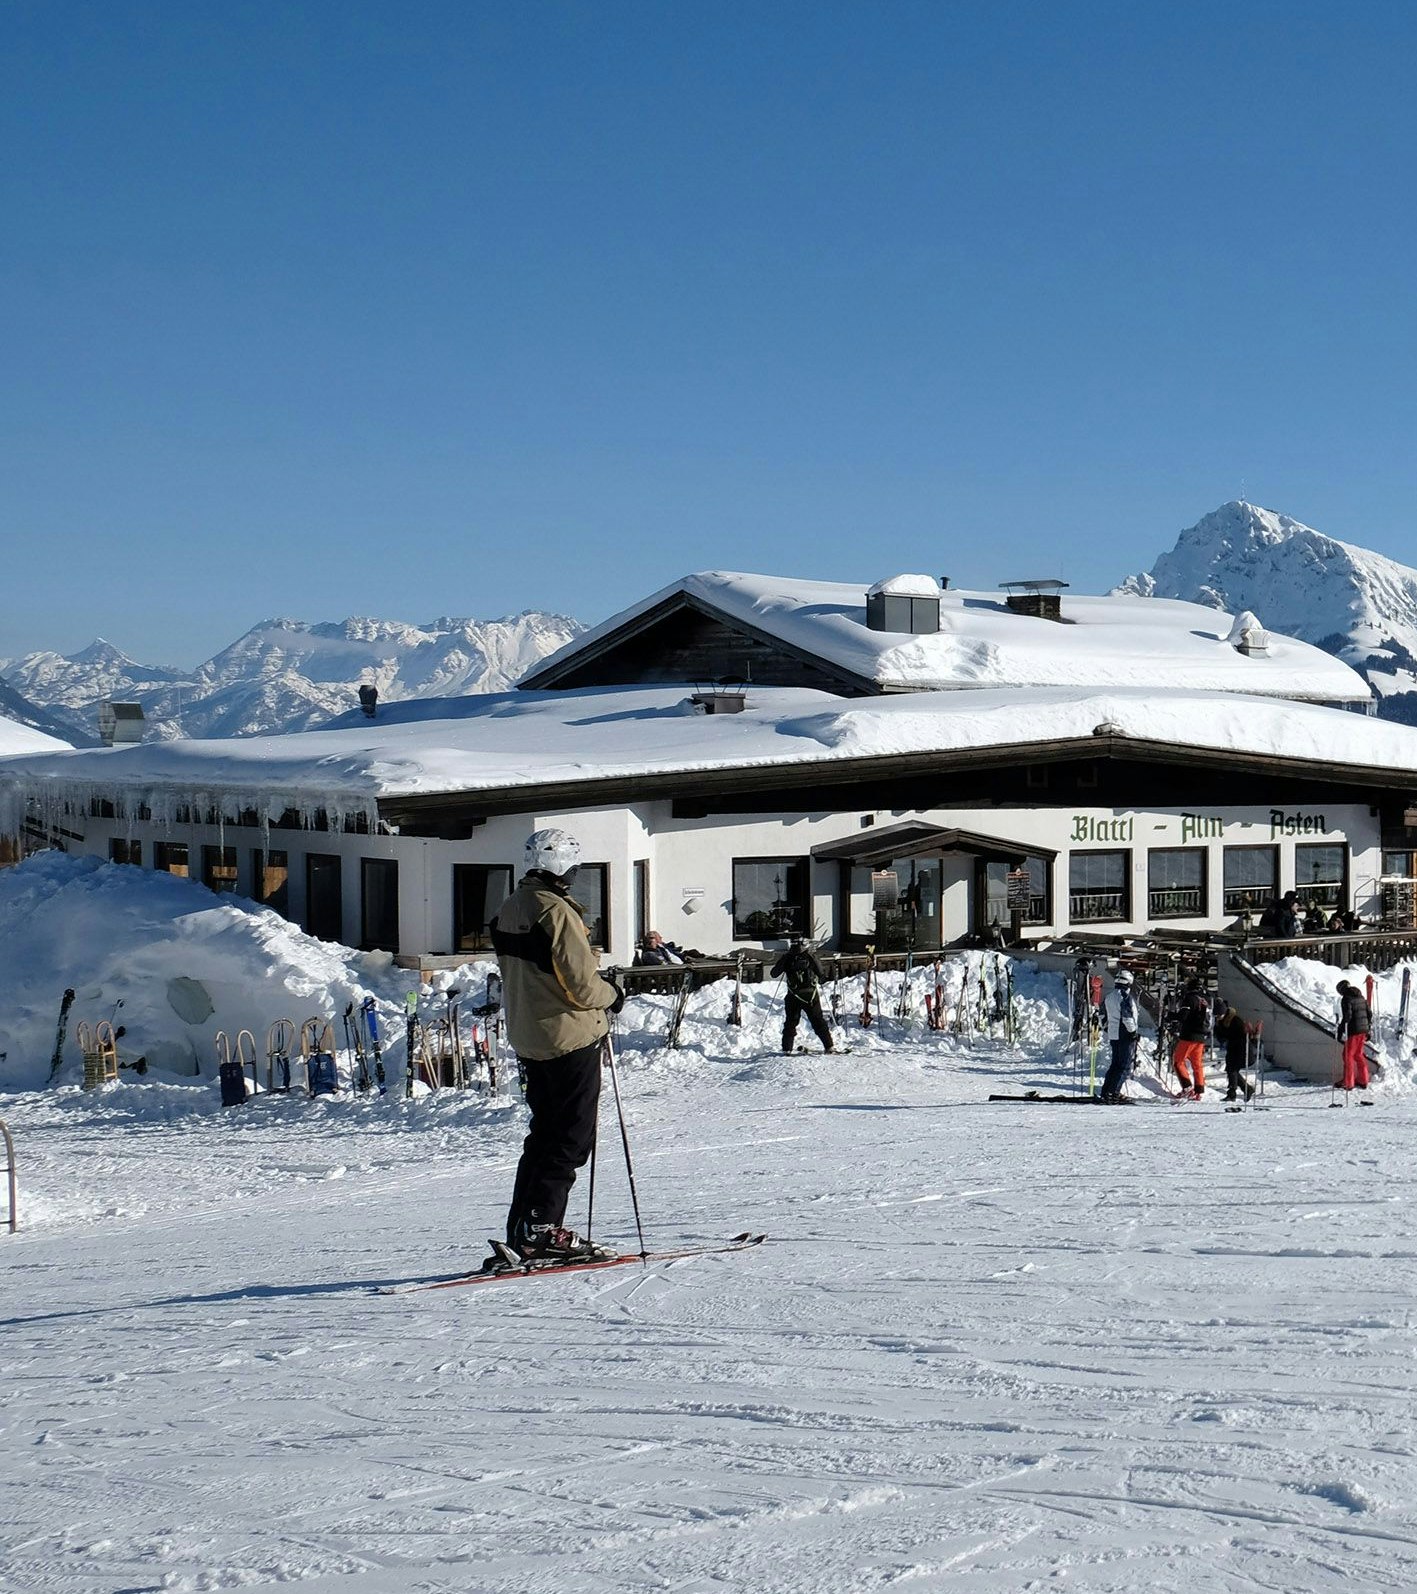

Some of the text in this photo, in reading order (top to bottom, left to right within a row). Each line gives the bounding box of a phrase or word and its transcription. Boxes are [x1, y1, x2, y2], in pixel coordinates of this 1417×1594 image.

[1070, 815, 1133, 841] Blattl
[1180, 812, 1224, 844] Alm
[1269, 809, 1326, 841] Asten
